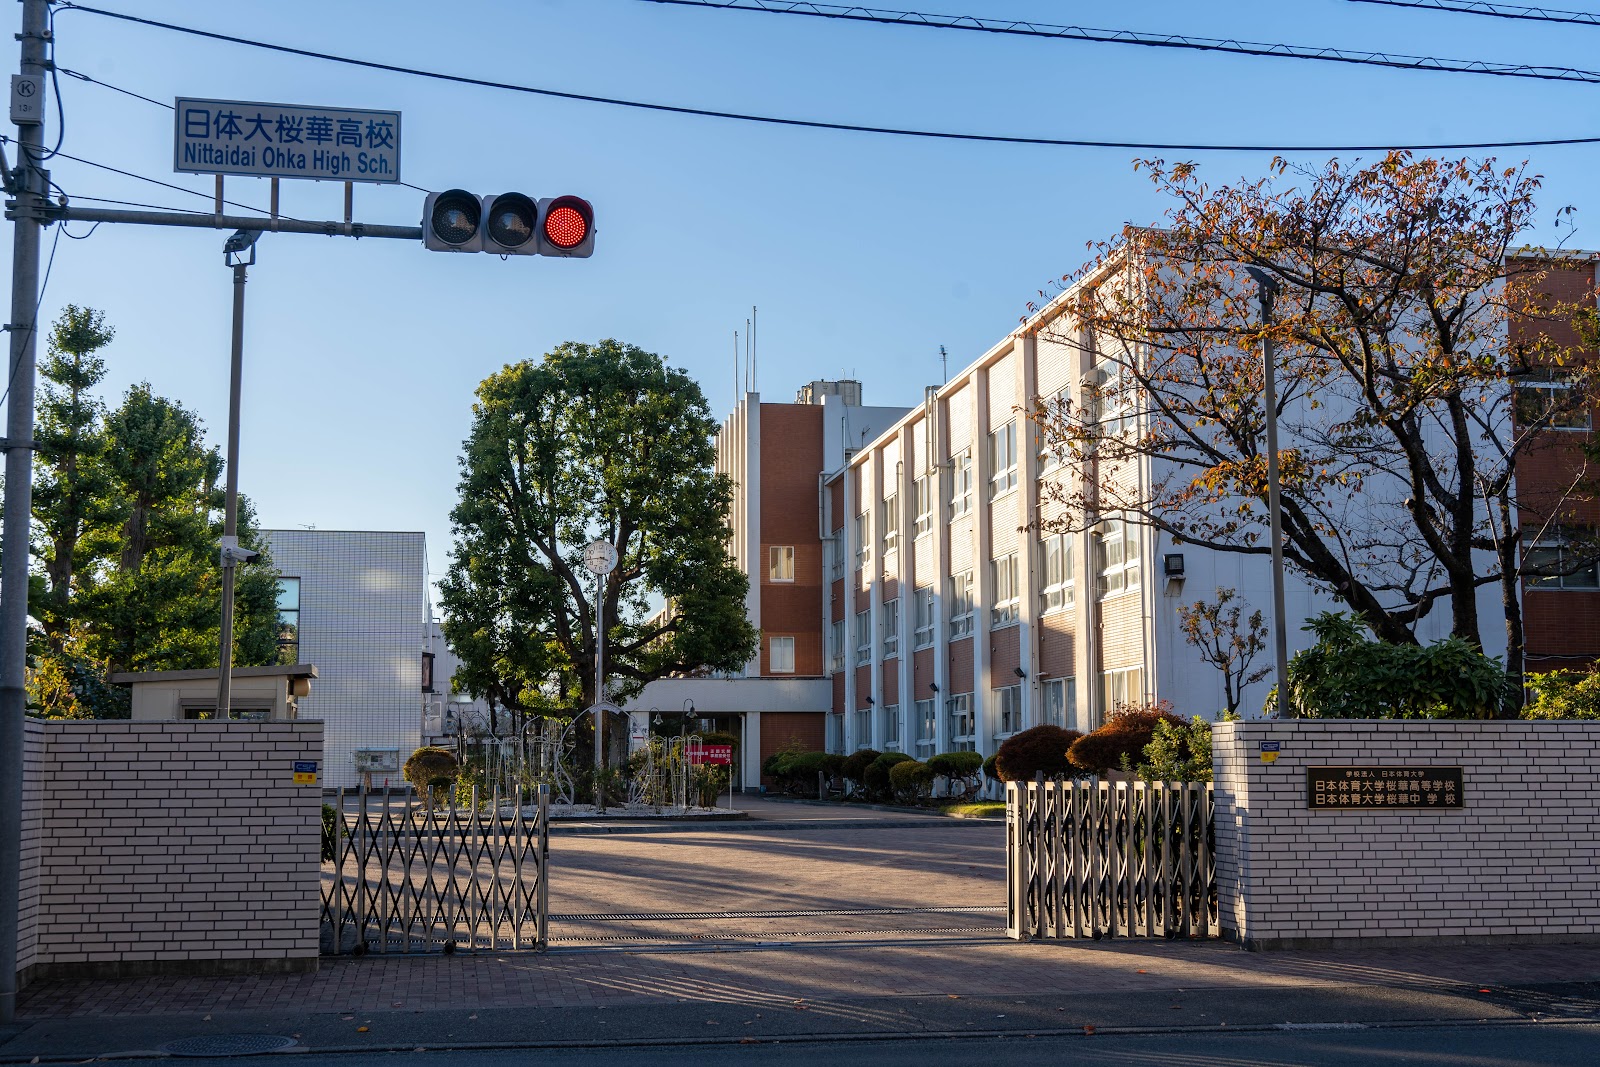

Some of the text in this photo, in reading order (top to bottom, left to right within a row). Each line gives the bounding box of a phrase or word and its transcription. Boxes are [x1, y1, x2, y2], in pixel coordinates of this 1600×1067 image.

[185, 108, 394, 149] 日体大桜華高校
[184, 142, 394, 175] Nittaidai Ohka High Sch.
[1381, 770, 1425, 778] 日本体育大学
[1315, 780, 1456, 792] 日本体育大学桜華高等学校
